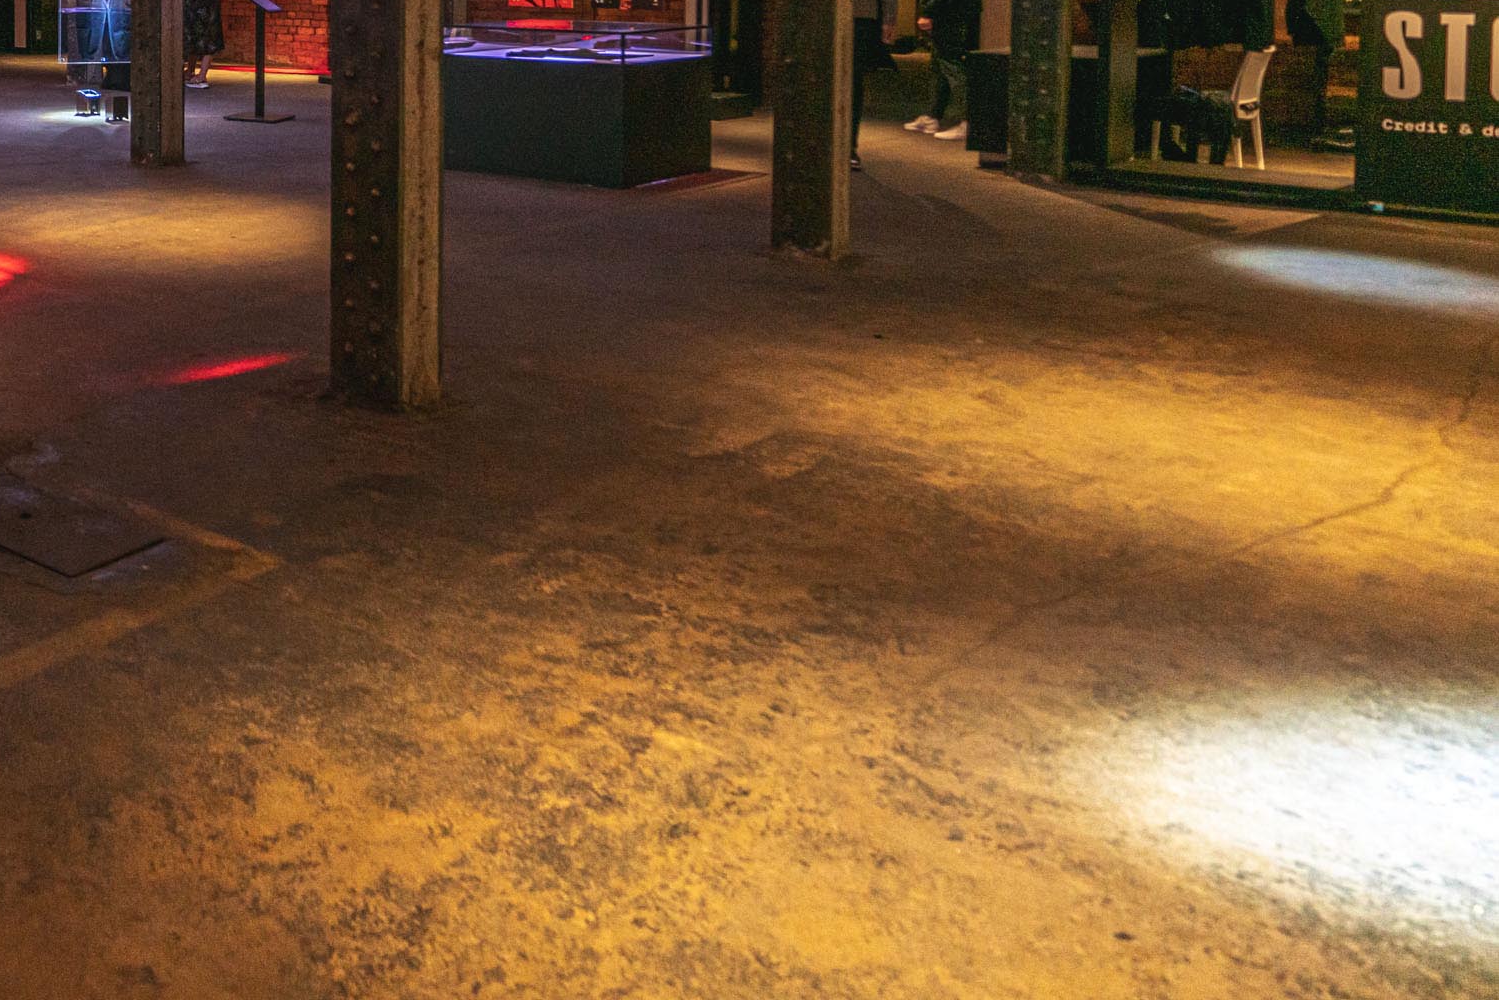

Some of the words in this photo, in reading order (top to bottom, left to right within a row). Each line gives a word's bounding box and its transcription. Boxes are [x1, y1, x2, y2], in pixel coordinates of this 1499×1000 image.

[1381, 10, 1499, 102] ST
[1381, 118, 1448, 134] Credit
[1459, 123, 1473, 136] &
